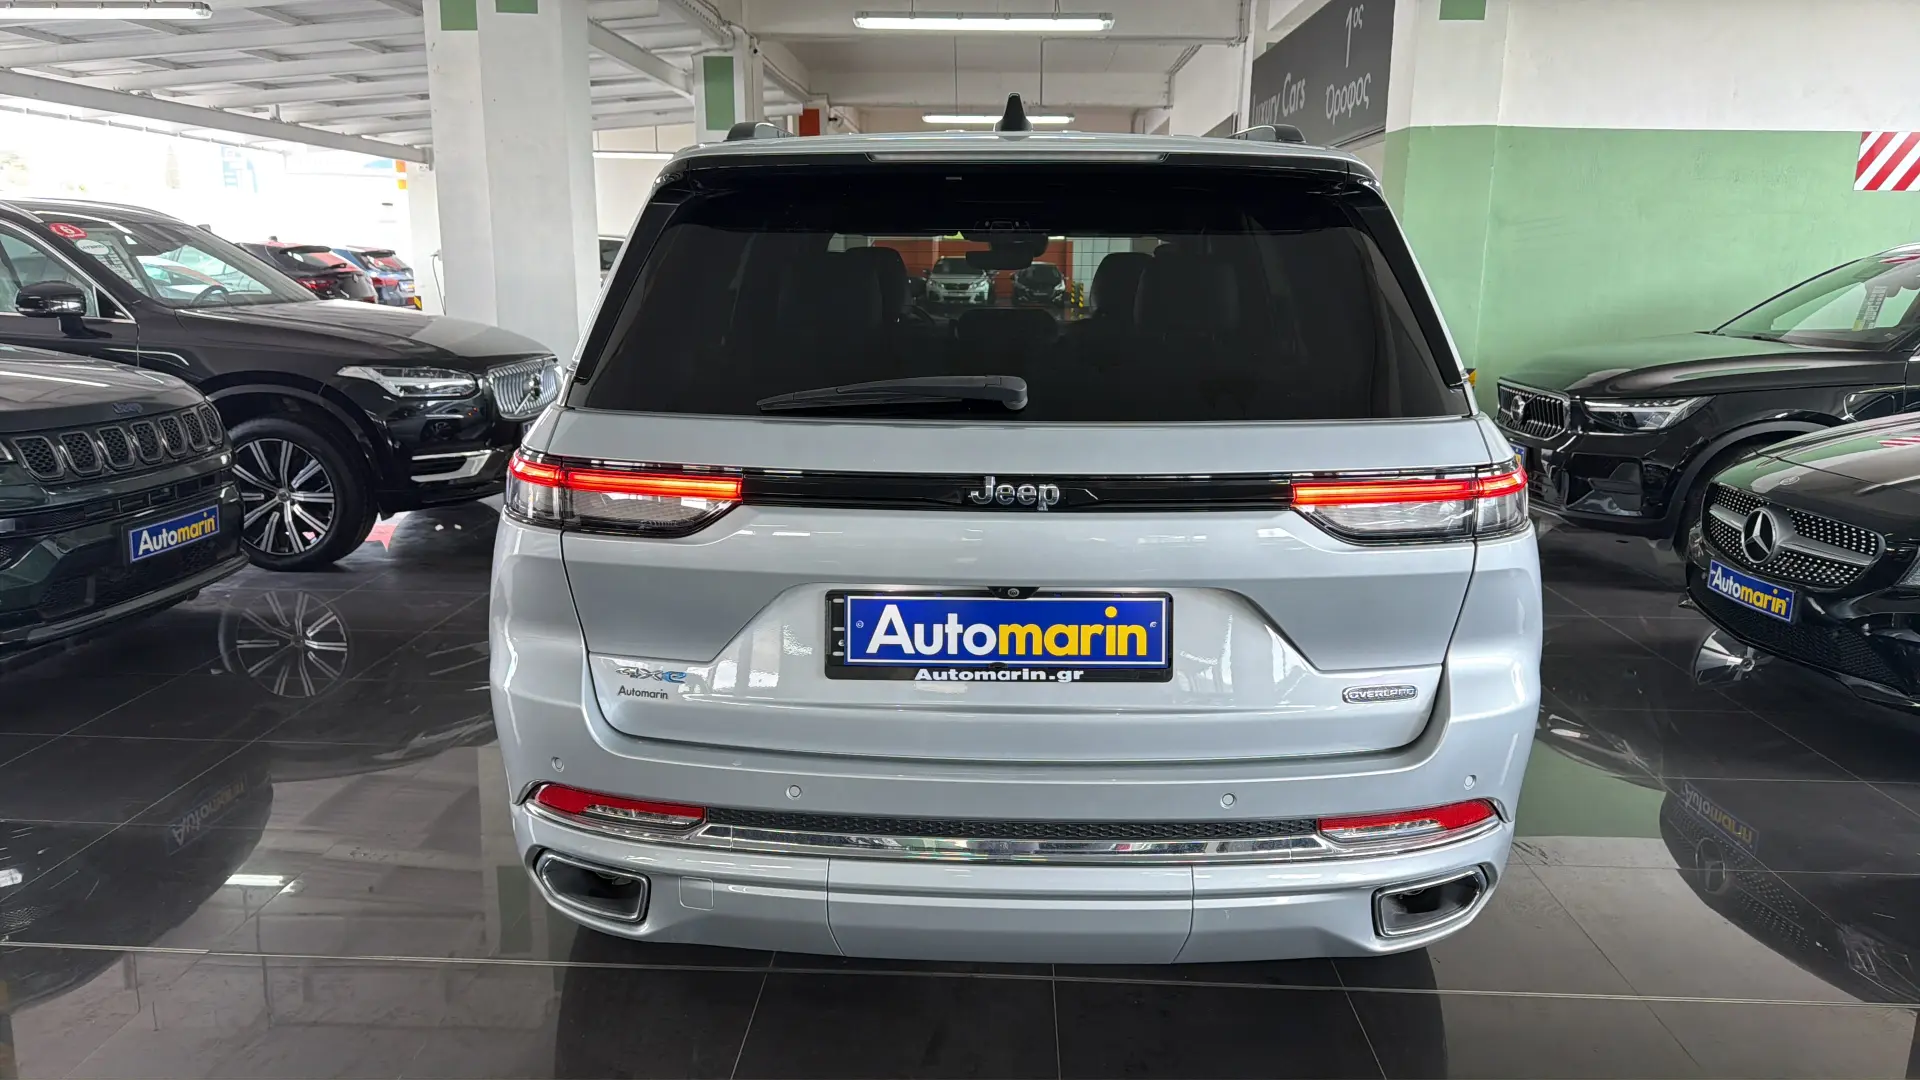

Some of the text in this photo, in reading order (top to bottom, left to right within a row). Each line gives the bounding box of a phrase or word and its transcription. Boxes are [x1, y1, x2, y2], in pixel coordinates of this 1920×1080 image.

[1282, 72, 1305, 117] Cars
[969, 476, 1060, 511] Jeep
[138, 512, 216, 555] Automarin
[1712, 565, 1787, 616] Automarin
[865, 604, 1148, 656] Automarin
[617, 684, 669, 699] Automarin
[914, 668, 1085, 683] Automarin.gr
